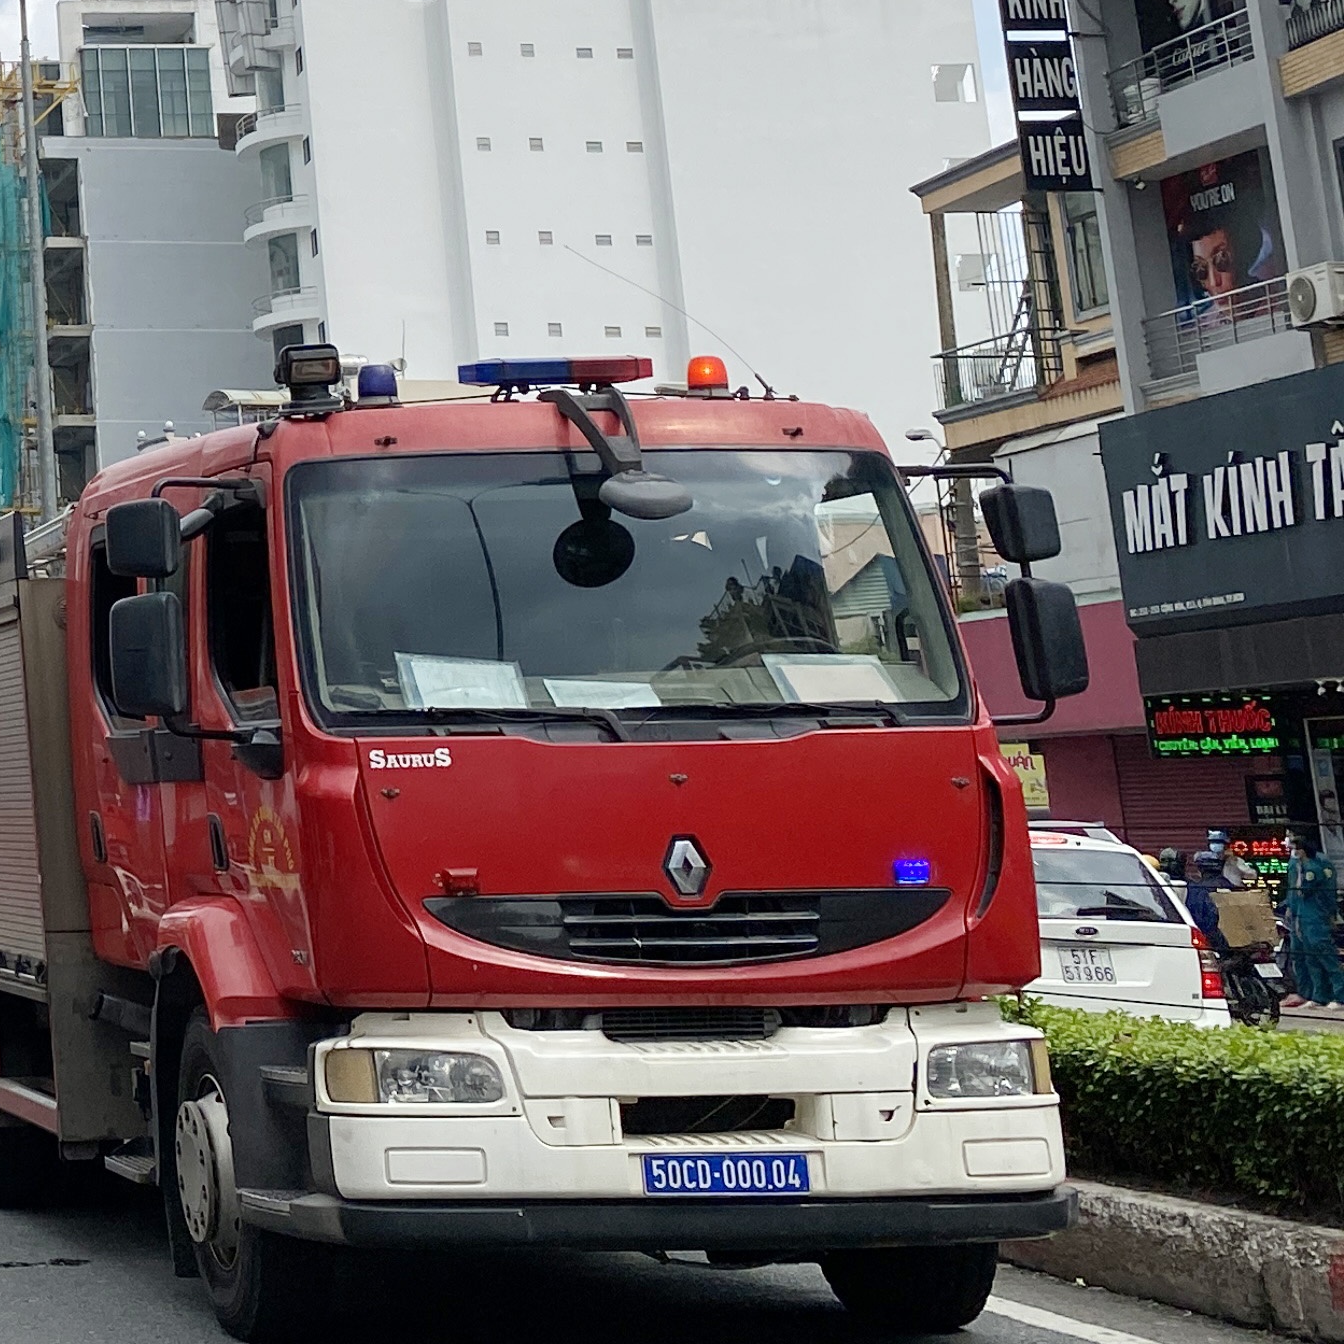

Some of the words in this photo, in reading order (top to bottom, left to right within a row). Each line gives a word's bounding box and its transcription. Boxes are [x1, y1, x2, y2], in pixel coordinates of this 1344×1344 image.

[1014, 47, 1078, 99] HÀNG
[1027, 127, 1087, 185] HIỆU
[1122, 452, 1188, 554] MẮT
[1203, 450, 1295, 539] KÍNH
[1155, 706, 1204, 735] KÍNH
[1205, 700, 1272, 733] THUỐC
[651, 1159, 801, 1190] 50CD-000.04
